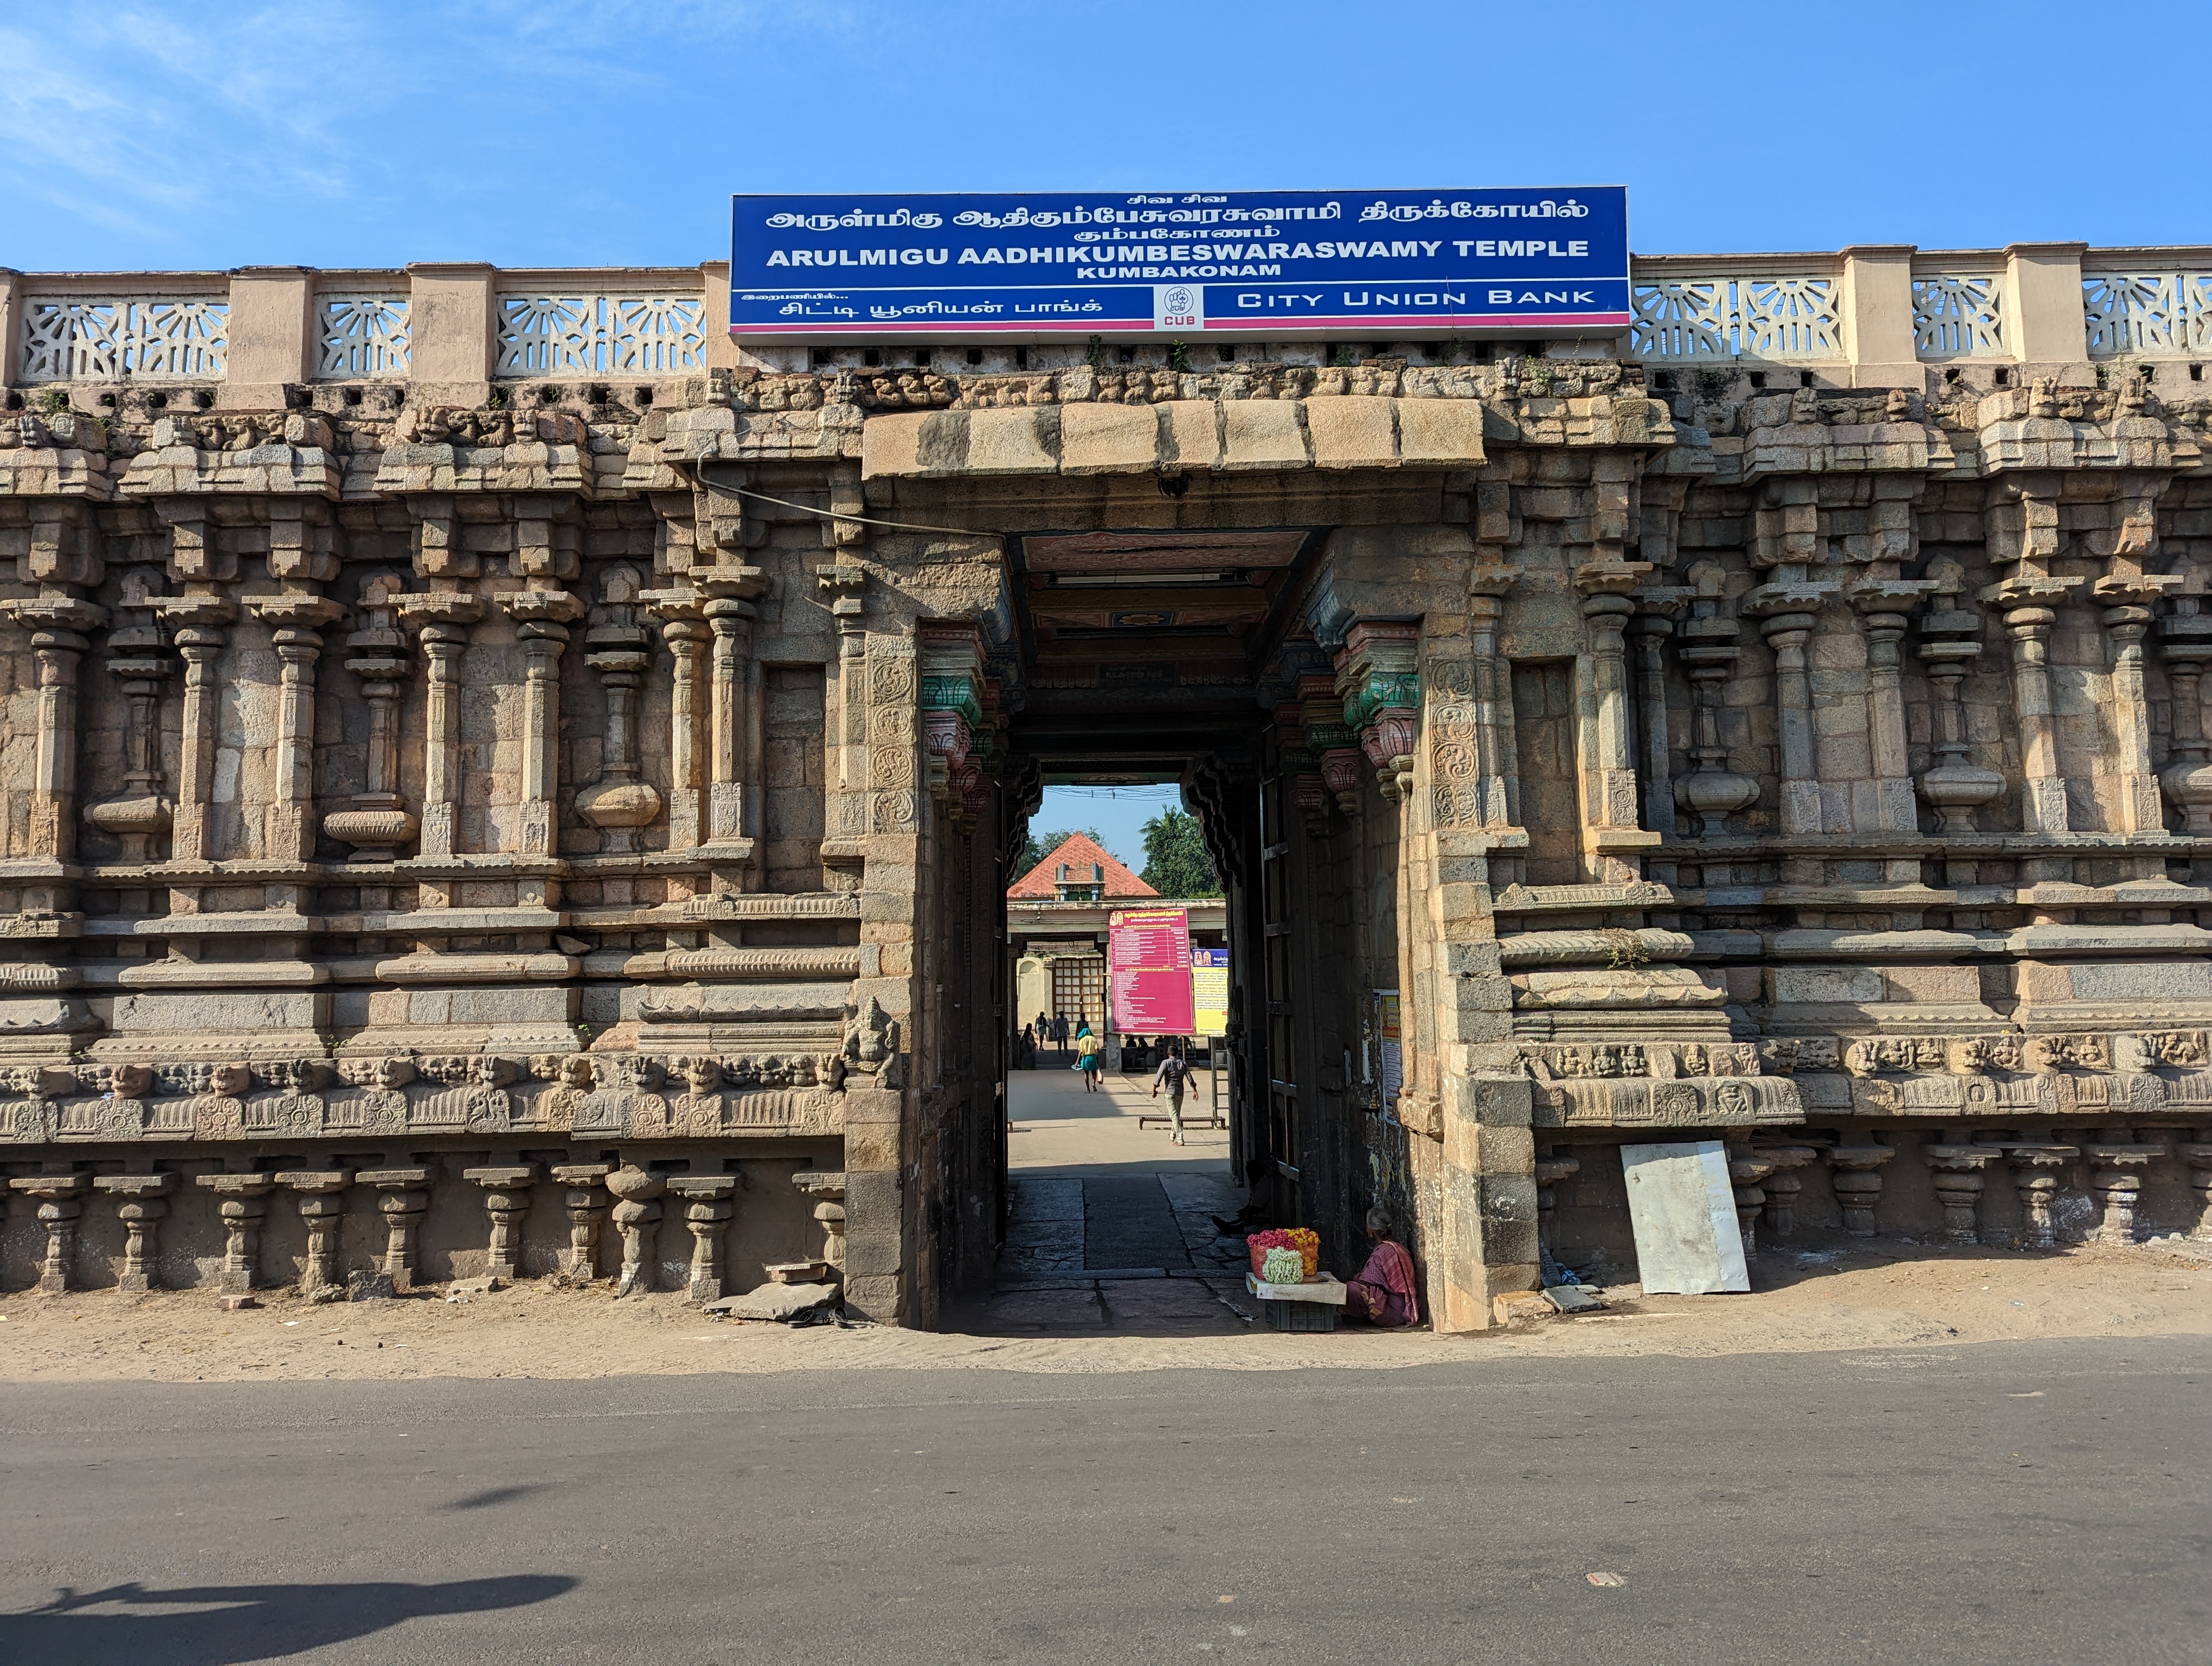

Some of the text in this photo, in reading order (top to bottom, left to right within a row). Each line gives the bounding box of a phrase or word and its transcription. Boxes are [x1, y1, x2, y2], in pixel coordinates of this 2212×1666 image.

[1127, 194, 1227, 204] சிவ சிவ
[766, 199, 1589, 231] அருள்மிகு ஆதிகும்பேசுவரசுவாமி திருக்கோயில்
[1073, 225, 1280, 242] கும்பகோணம்
[766, 240, 1589, 267] ARULMIGU AADHIKUMBESWARASWAMY TEMPLE
[1077, 264, 1281, 279] KUMBAKONAM
[779, 299, 1103, 319] சிட்டி யூனியன் பாங்க்
[1164, 316, 1195, 325] CUB
